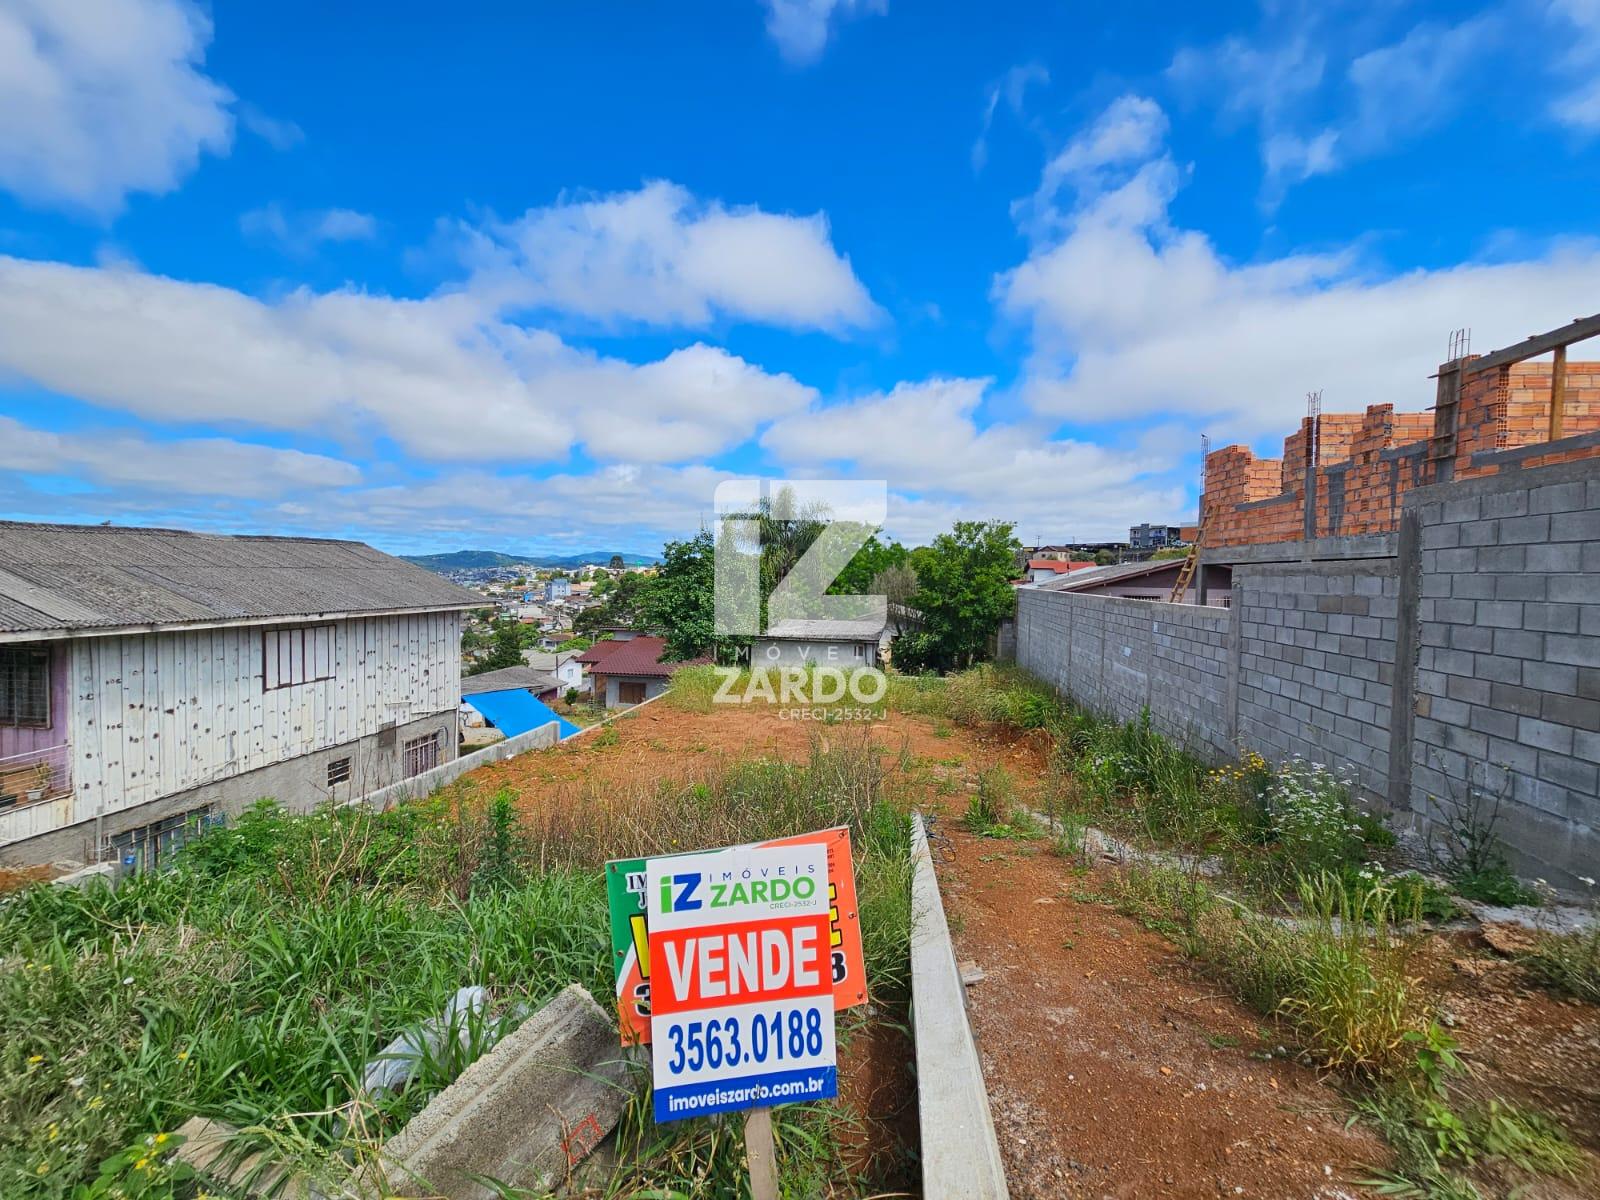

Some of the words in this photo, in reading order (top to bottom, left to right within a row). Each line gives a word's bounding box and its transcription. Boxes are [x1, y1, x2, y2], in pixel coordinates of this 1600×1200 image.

[709, 864, 815, 882] IMÓVEIS
[709, 876, 815, 909] ZARDO
[663, 925, 819, 1002] VENDE
[668, 1008, 823, 1075] 3563.0188
[669, 1077, 824, 1112] imoveiszardo.com.br
